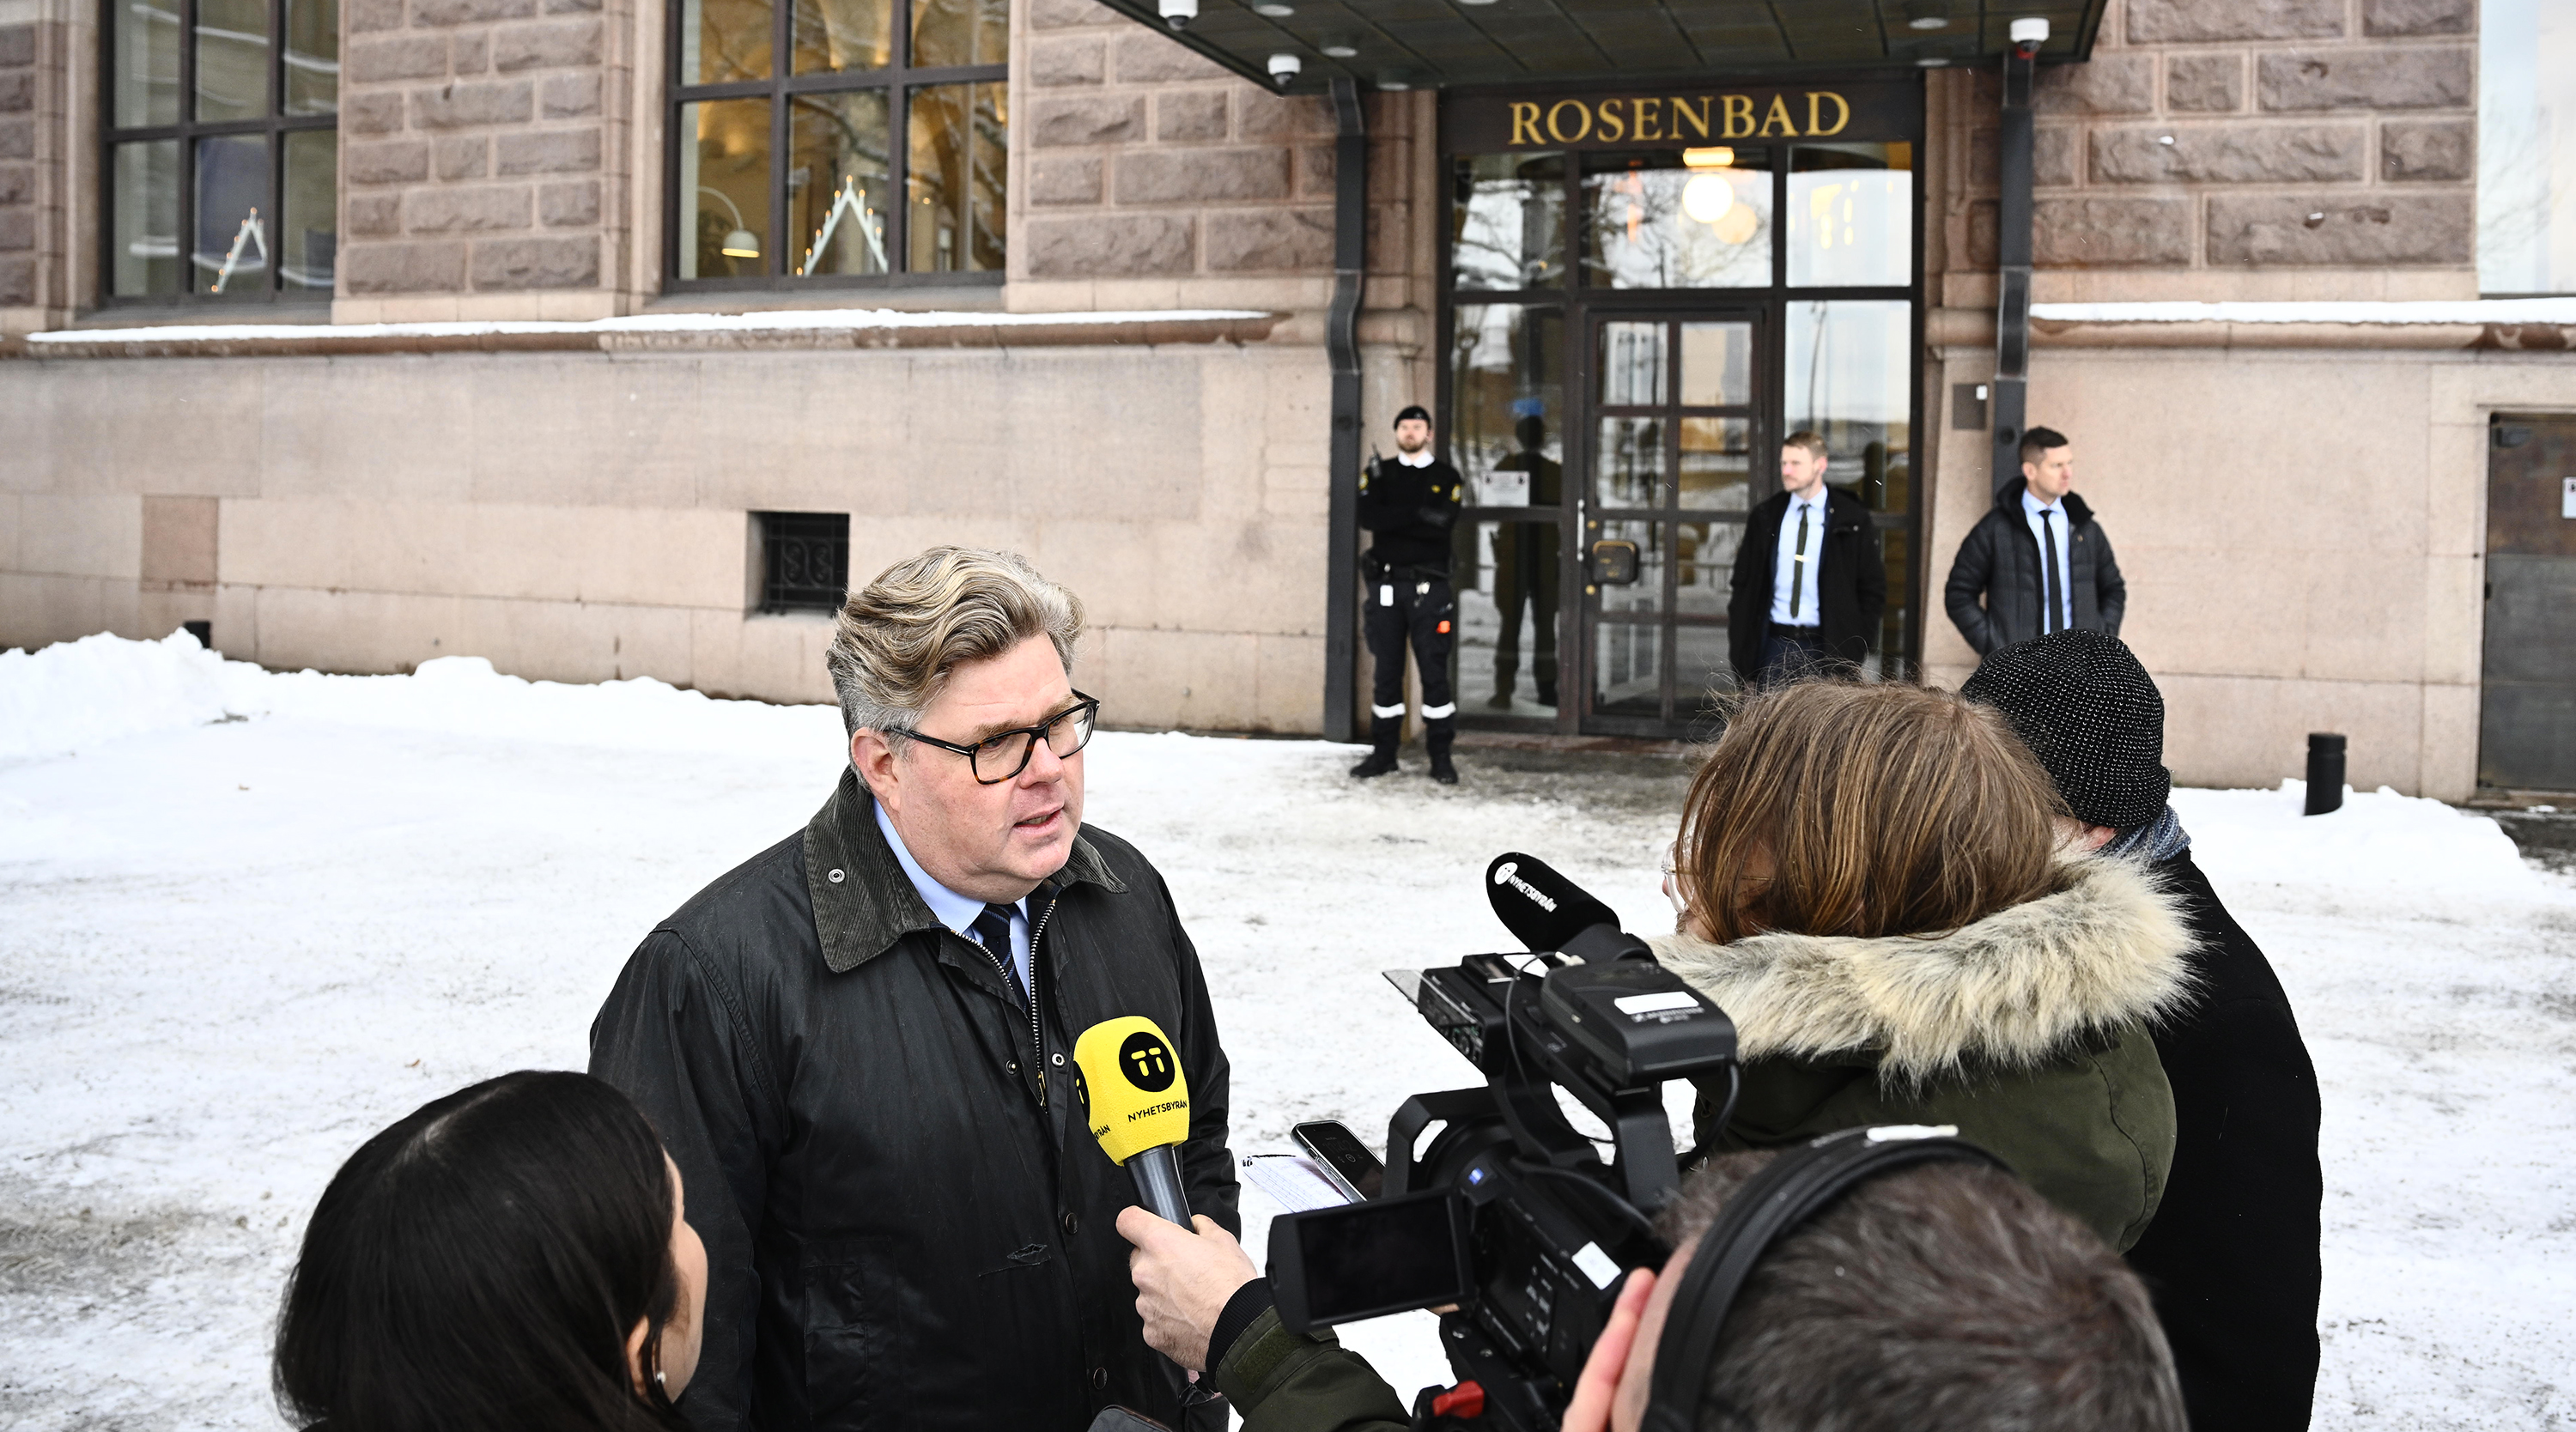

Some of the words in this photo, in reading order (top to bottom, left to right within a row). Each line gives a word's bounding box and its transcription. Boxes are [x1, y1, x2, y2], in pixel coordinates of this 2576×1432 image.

[1509, 91, 1850, 146] ROSENBAD
[1508, 874, 1558, 913] NYHETSBYRÅN
[1127, 1099, 1188, 1123] NYHETSBYRÅN
